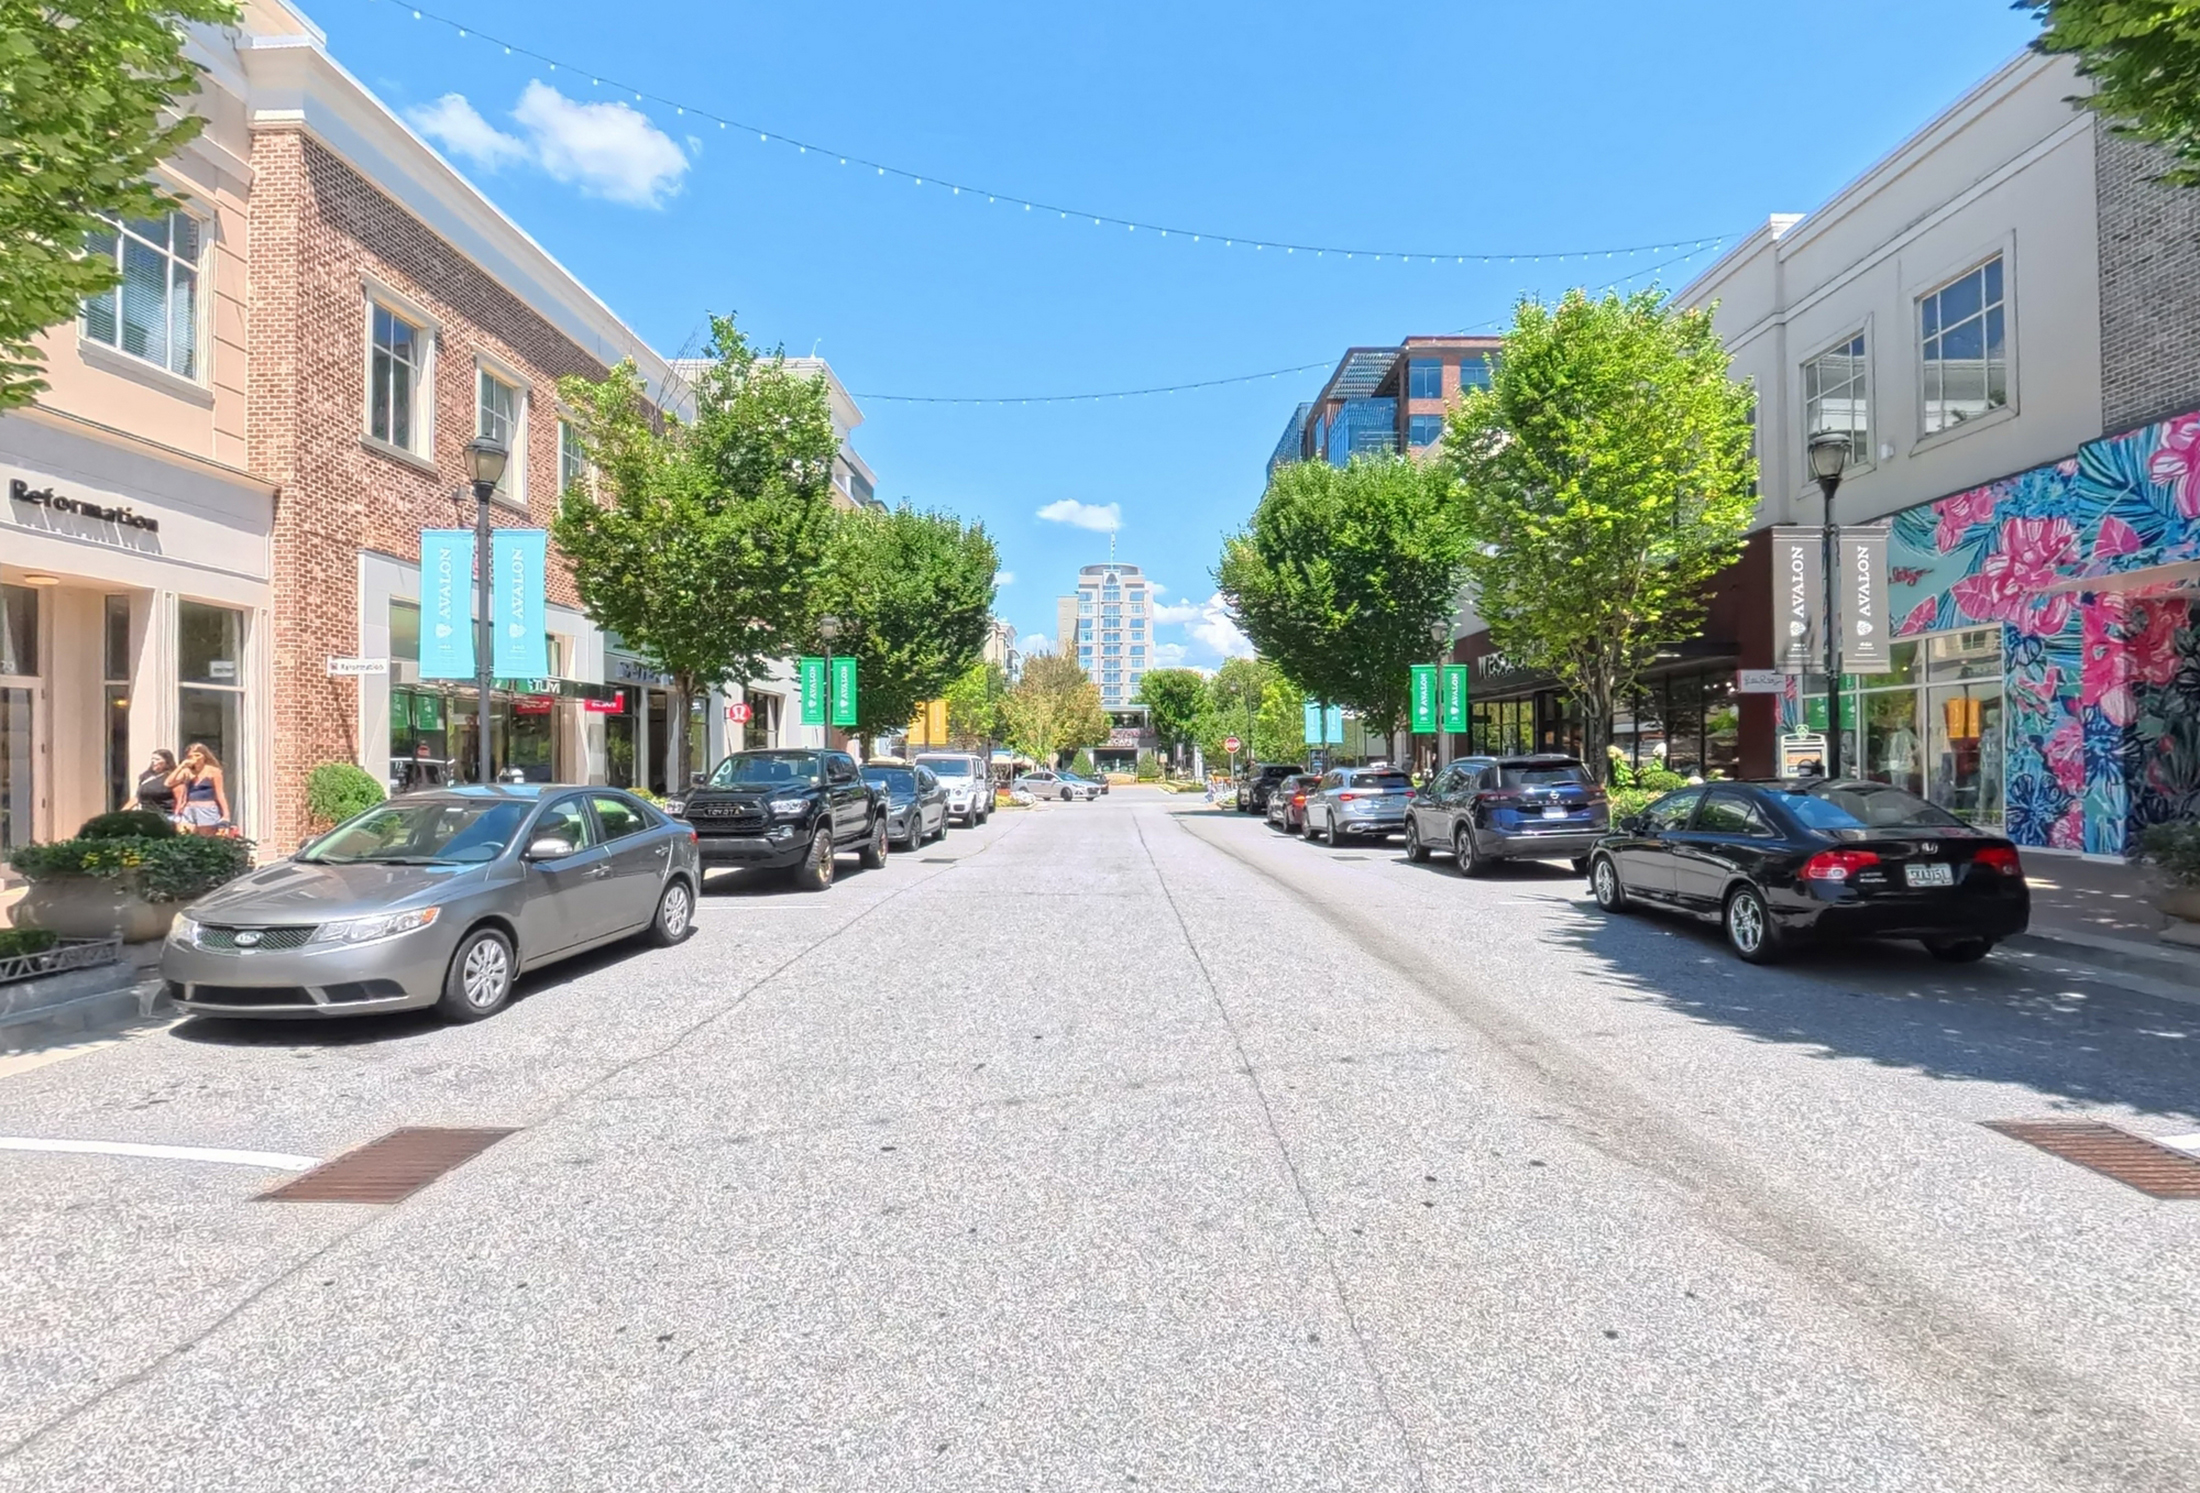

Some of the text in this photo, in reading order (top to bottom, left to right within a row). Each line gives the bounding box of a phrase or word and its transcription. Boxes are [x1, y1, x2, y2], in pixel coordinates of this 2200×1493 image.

[10, 478, 159, 533] Reformation
[438, 547, 452, 620] AVALON
[511, 547, 525, 620] AVALON
[1791, 545, 1805, 618] AVALON
[1857, 545, 1871, 617] AVALON
[809, 665, 817, 699] AVALON
[840, 665, 849, 699] AVALON
[1420, 673, 1428, 706] AVALON
[1451, 673, 1459, 707] AVALON
[707, 808, 740, 816] TOYOTA
